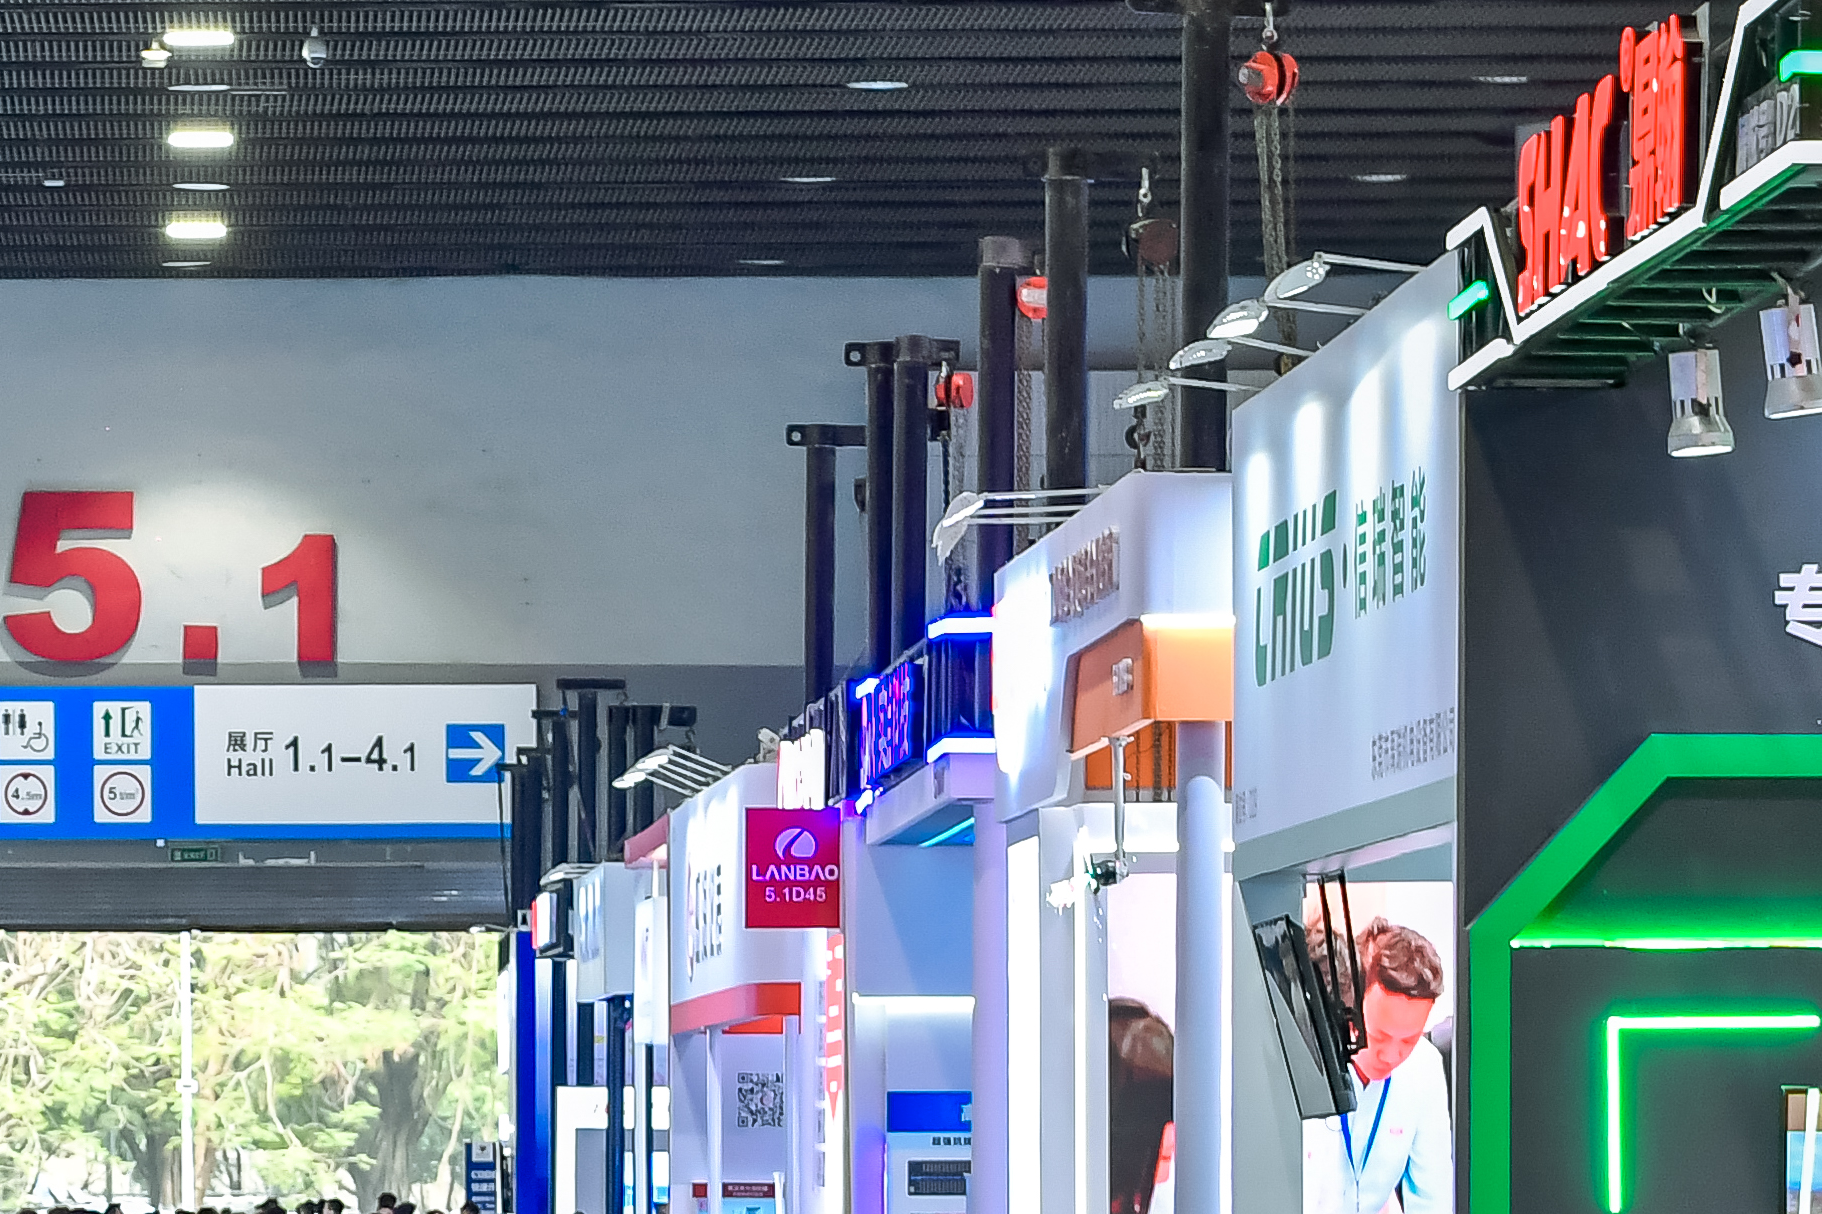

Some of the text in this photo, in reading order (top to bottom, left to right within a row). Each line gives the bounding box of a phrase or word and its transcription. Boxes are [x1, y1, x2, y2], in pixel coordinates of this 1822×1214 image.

[1, 490, 337, 663] 5.1
[103, 742, 141, 755] EXIT
[226, 730, 273, 754] 展厅
[226, 756, 274, 777] Hall
[751, 864, 839, 882] LANBAO
[765, 886, 826, 903] 5.1D45
